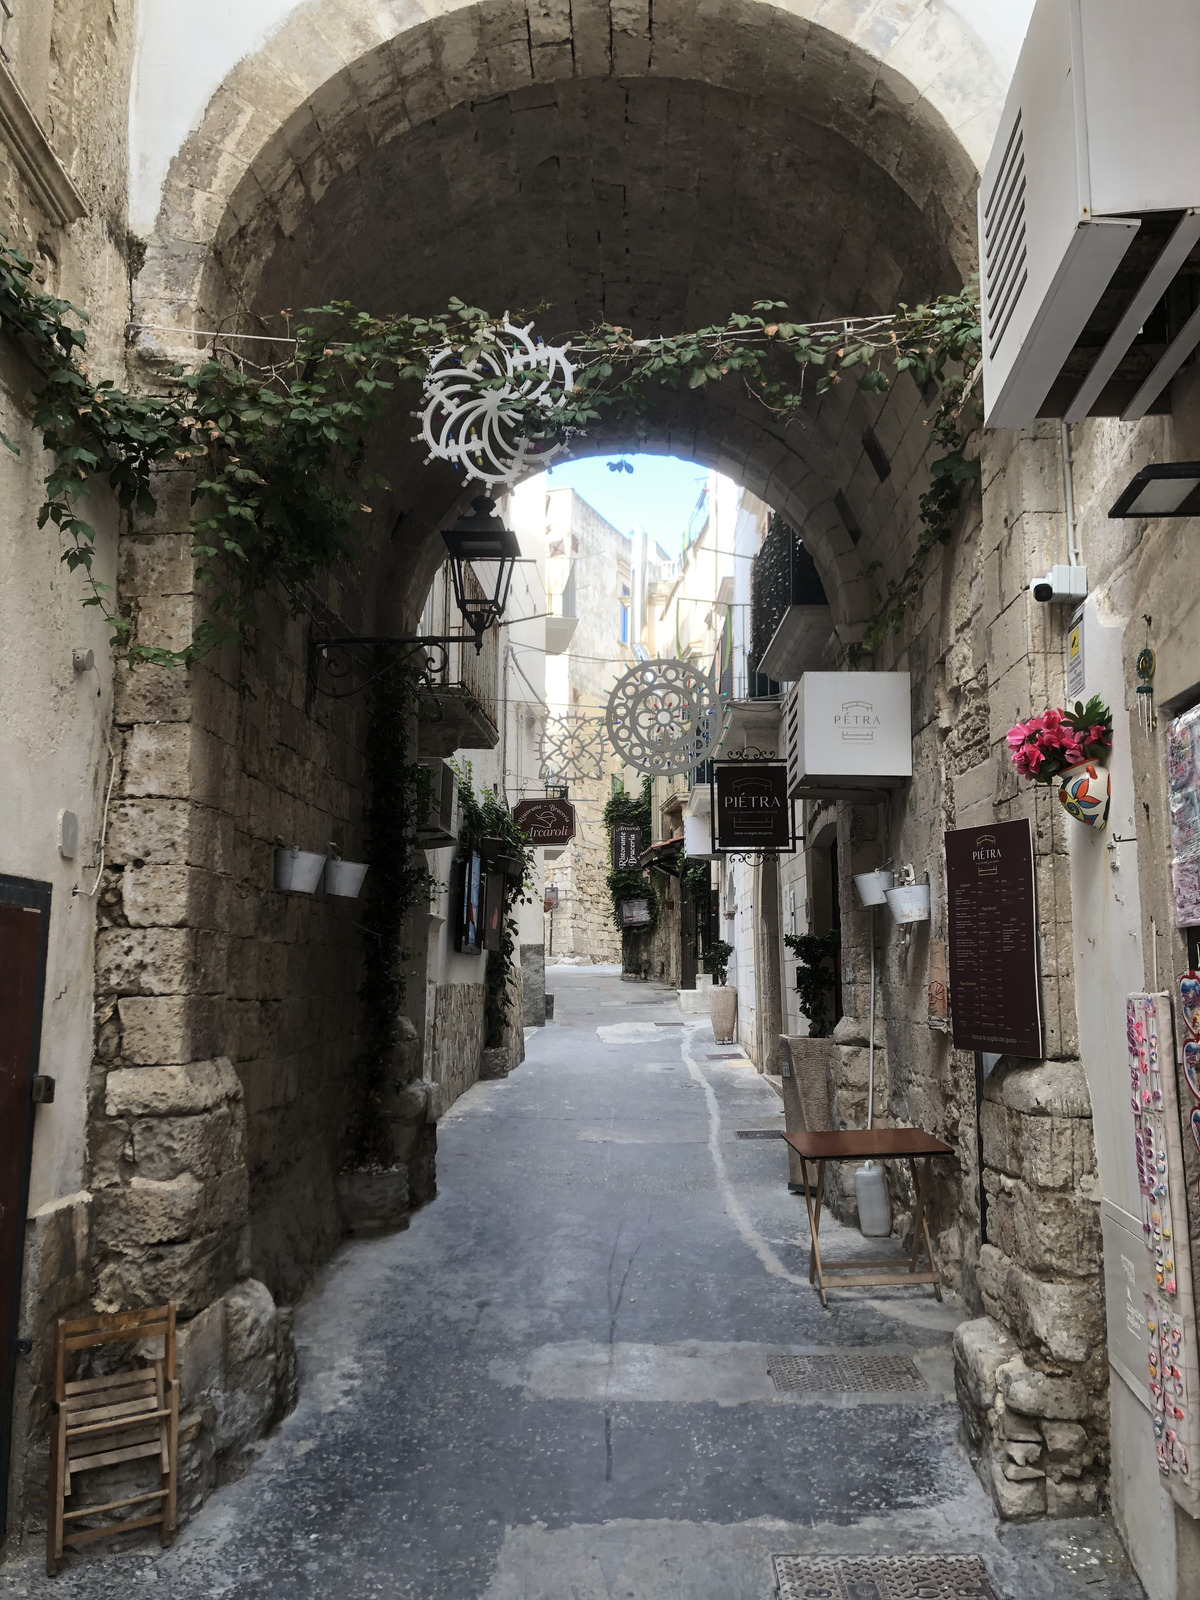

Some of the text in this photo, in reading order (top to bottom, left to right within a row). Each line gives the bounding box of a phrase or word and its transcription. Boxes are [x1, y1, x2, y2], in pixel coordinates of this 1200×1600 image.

[724, 792, 781, 808] PIÉTRA
[518, 804, 542, 824] Ristorante
[549, 804, 570, 823] Braceria
[527, 825, 569, 838] Arcaroli
[618, 831, 629, 869] Ristorante
[627, 833, 638, 867] Braceria
[972, 847, 1002, 861] PIÉTRA
